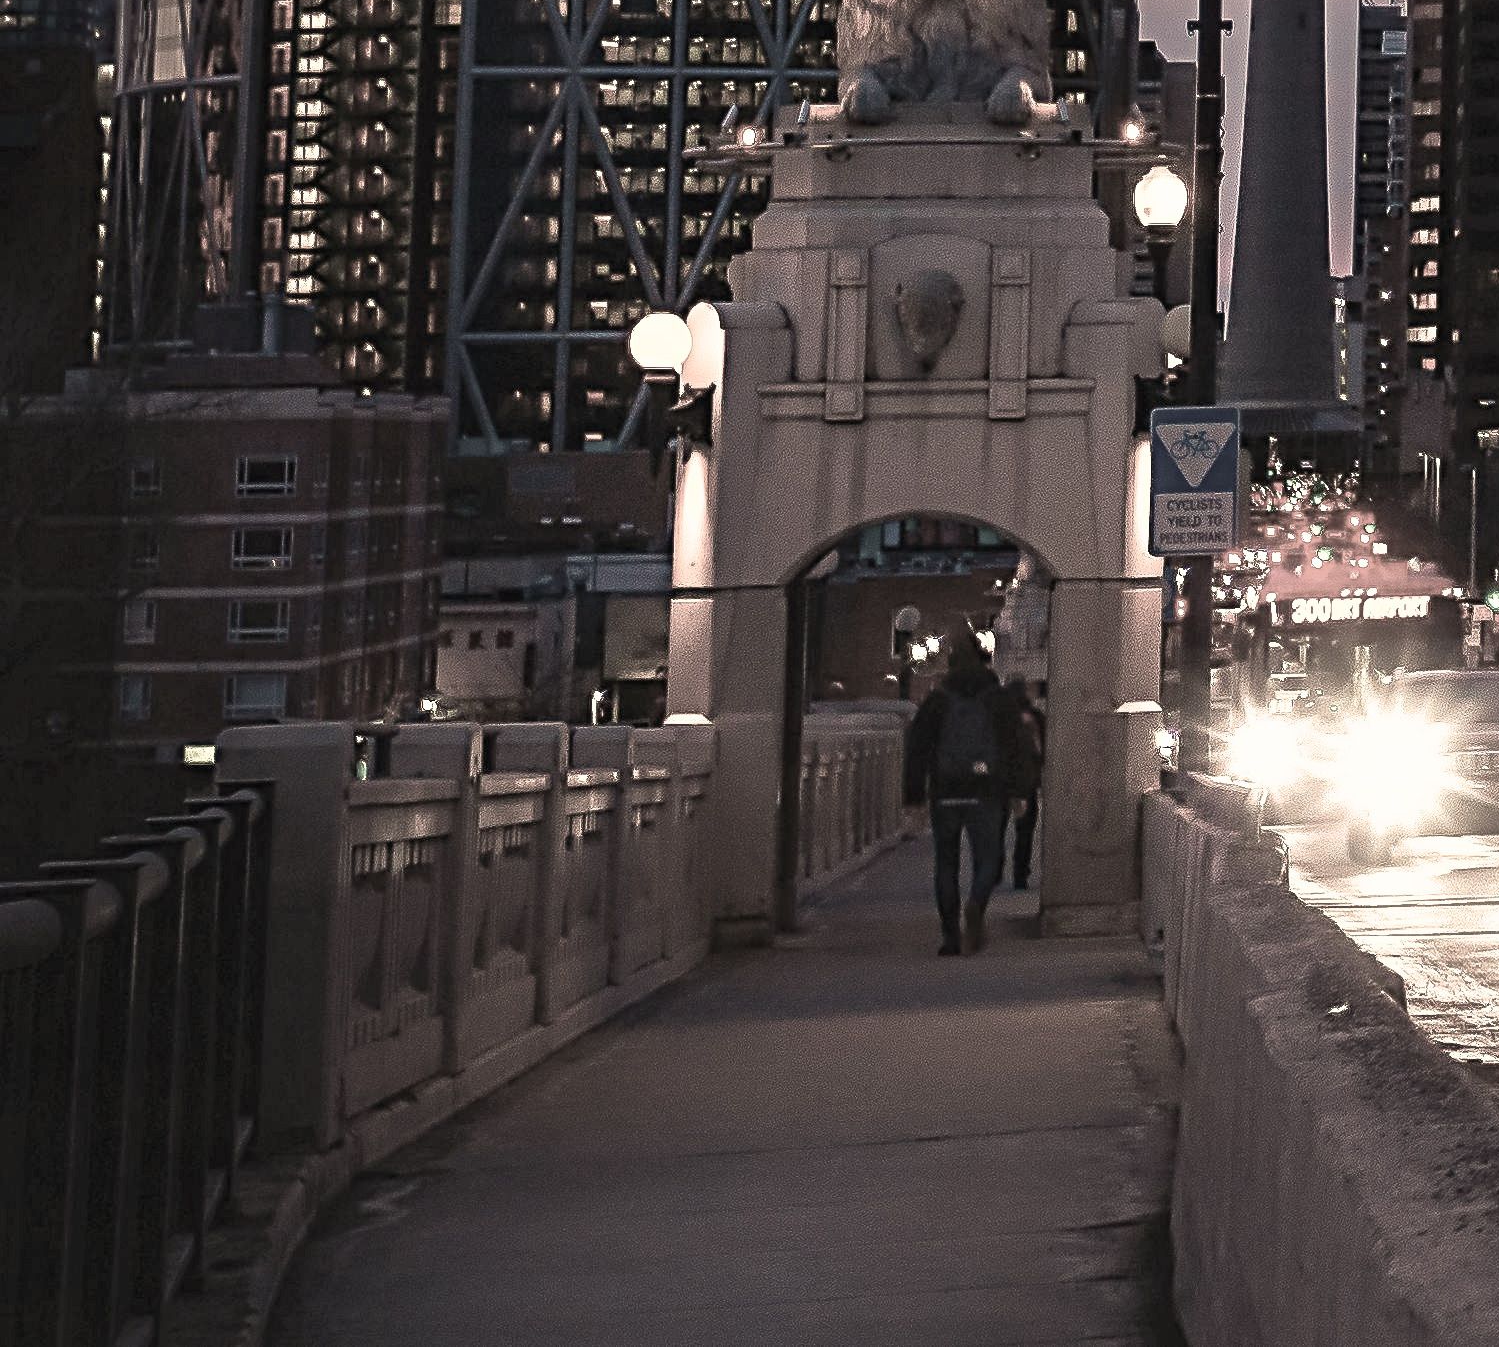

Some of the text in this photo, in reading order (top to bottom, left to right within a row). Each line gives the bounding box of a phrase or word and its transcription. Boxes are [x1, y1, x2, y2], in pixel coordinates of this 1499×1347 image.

[1166, 497, 1223, 511] CYCLISTS
[1167, 514, 1223, 528] YIELD TO
[1160, 531, 1228, 544] PEDESTRIANS
[1291, 597, 1331, 624] 300
